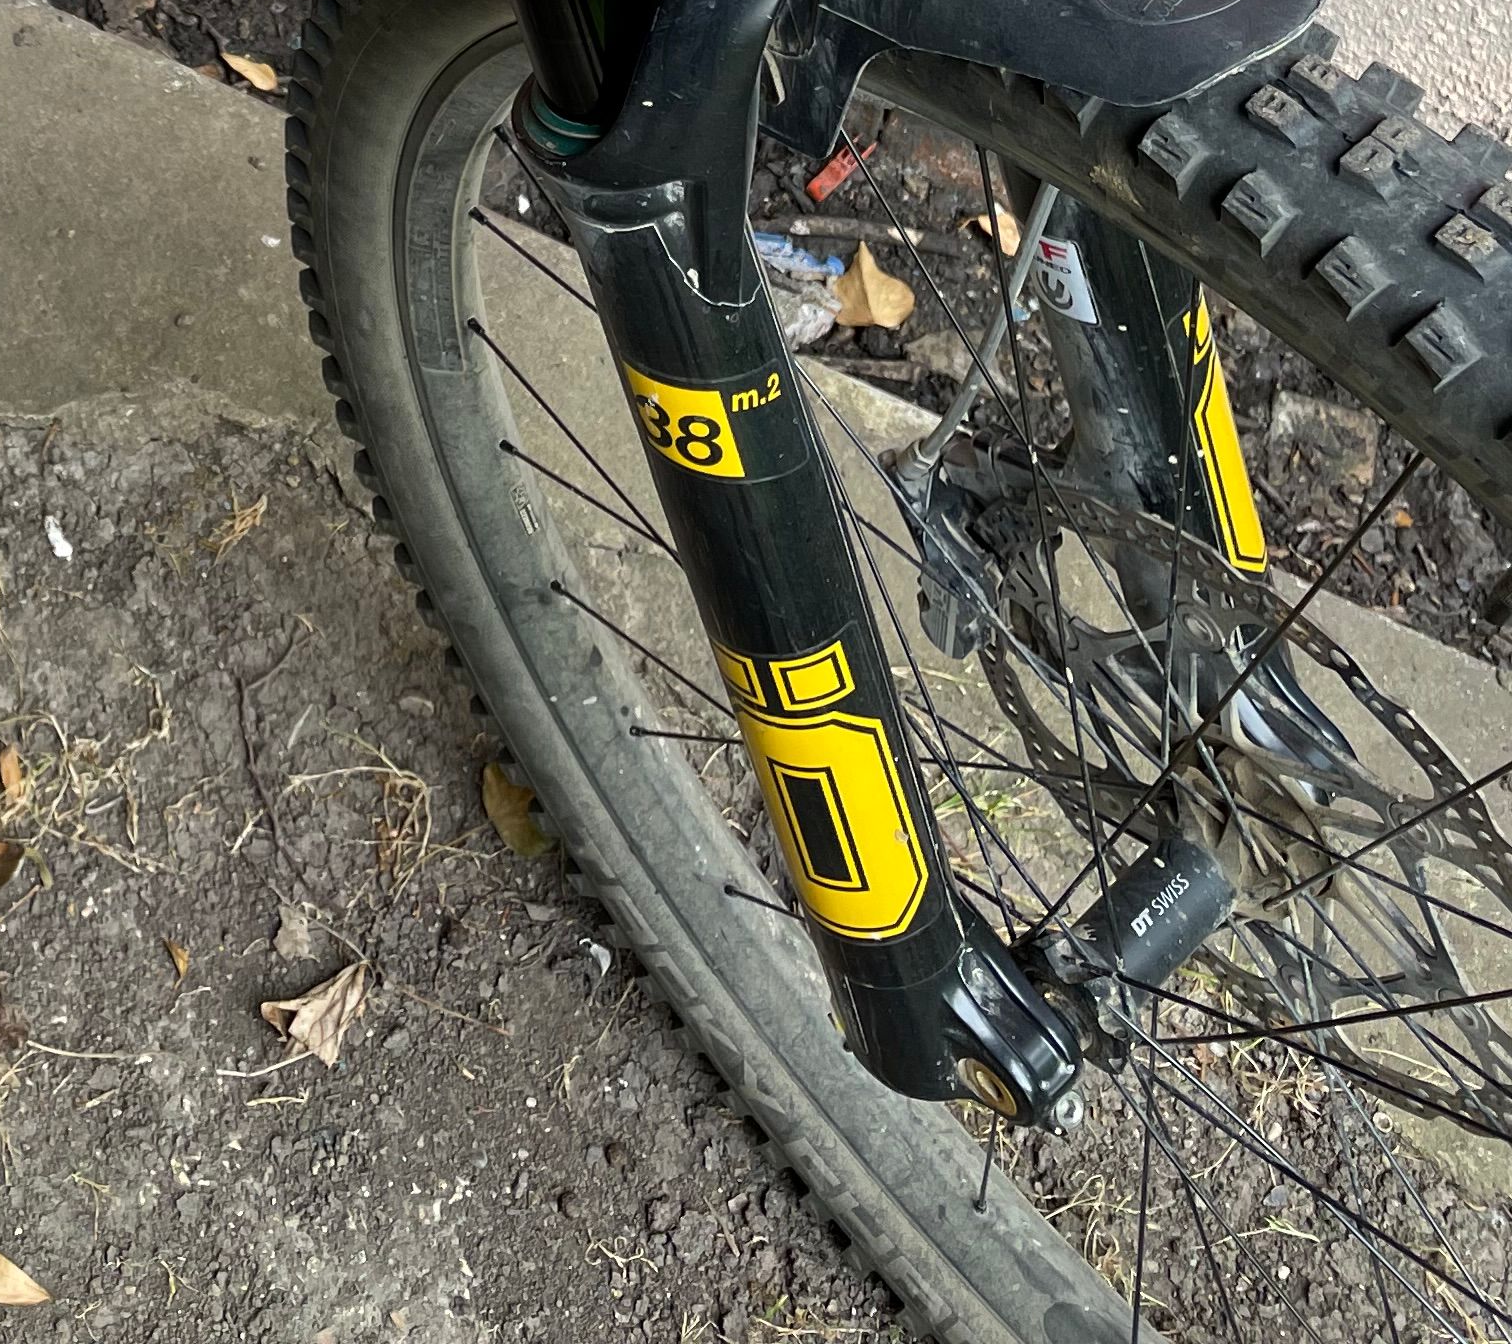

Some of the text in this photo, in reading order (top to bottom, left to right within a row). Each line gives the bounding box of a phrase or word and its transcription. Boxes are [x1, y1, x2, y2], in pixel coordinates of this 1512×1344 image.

[637, 373, 782, 466] 38 m.2
[1130, 873, 1190, 937] DT SWISS
